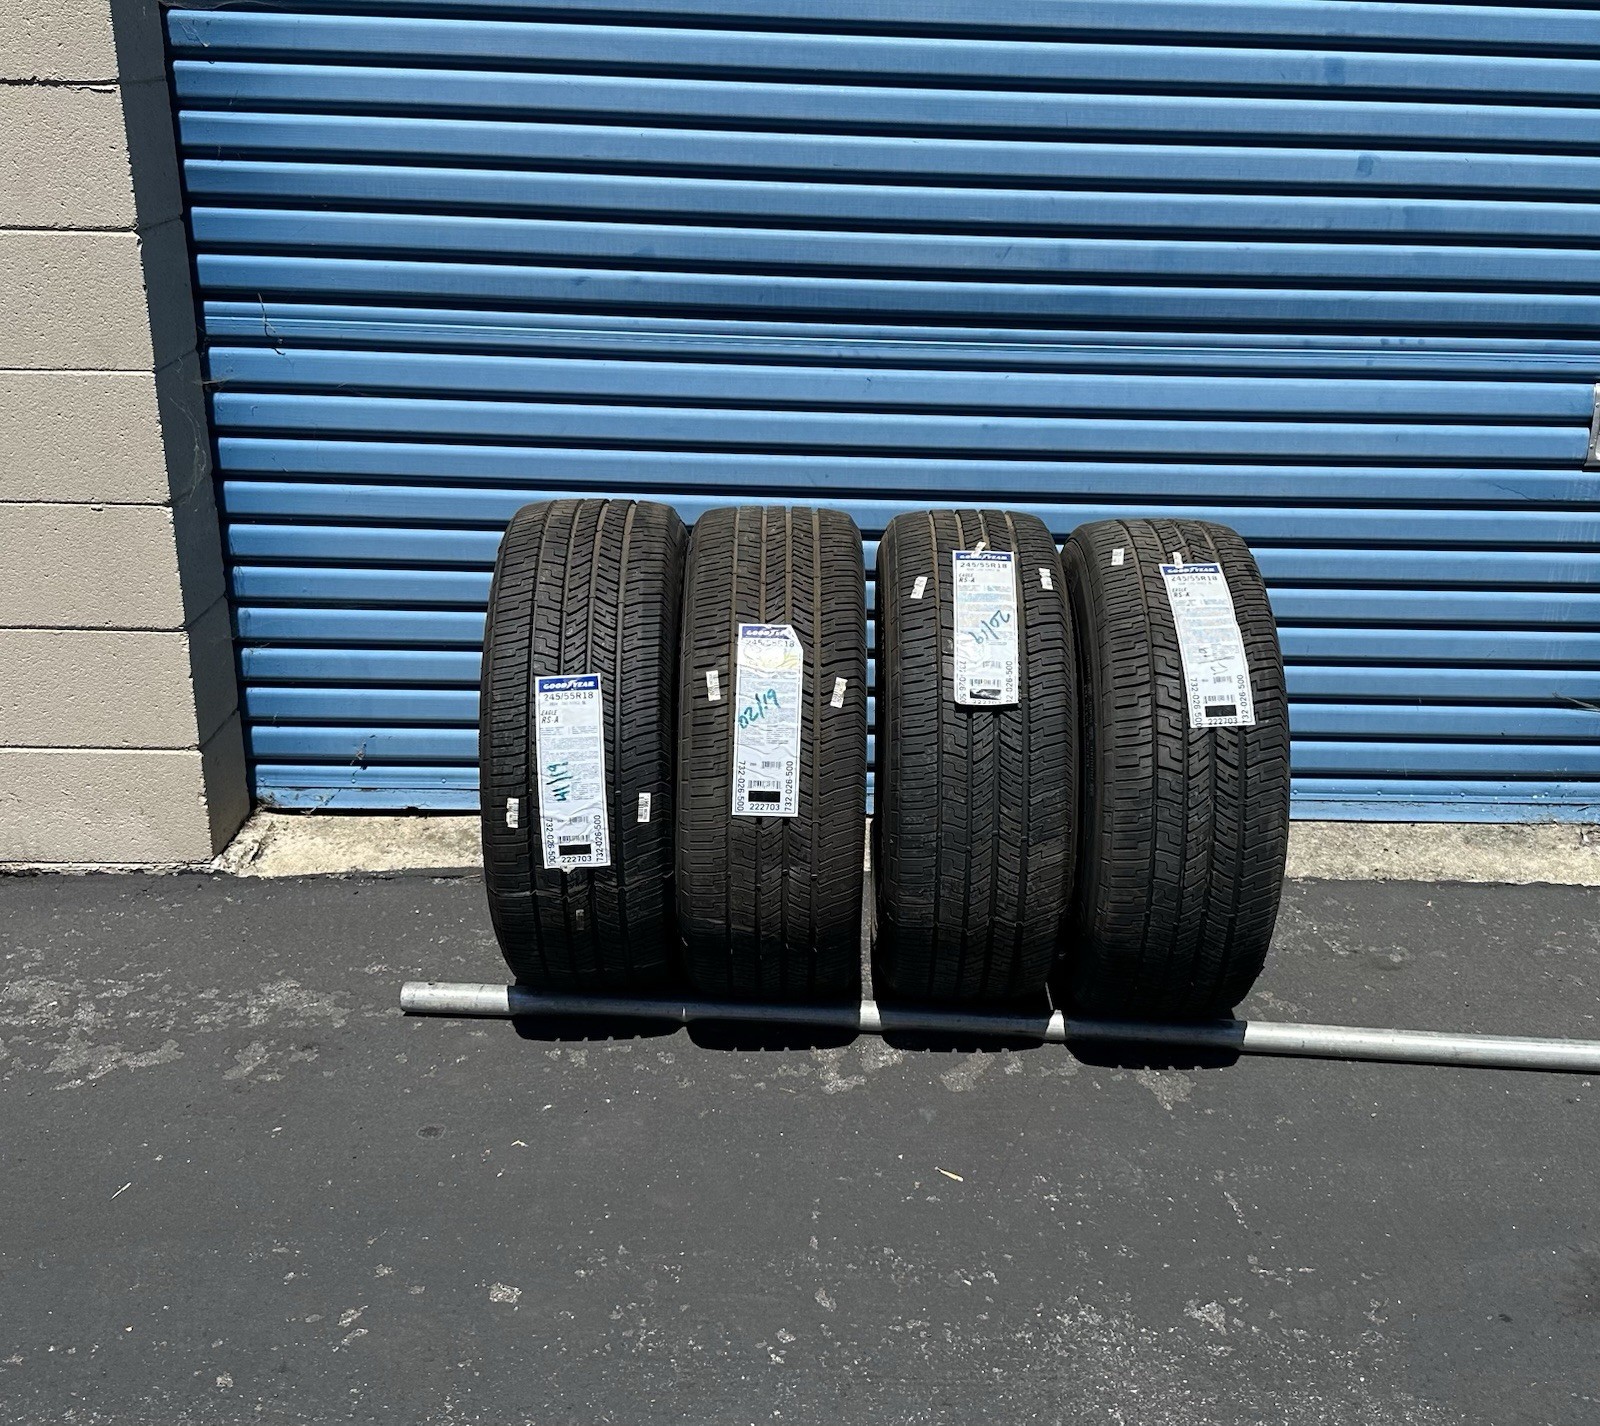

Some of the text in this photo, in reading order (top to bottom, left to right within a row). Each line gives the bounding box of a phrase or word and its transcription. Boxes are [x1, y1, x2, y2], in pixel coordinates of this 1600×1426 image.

[543, 680, 595, 690] GOODYEAR
[1005, 660, 1013, 703] 32-026-500
[543, 691, 594, 701] 245/55R18
[1190, 677, 1203, 727] 732-026-500
[1236, 674, 1250, 724] 732-026-500
[541, 716, 559, 724] RS-A
[1208, 717, 1238, 725] 222703
[736, 760, 746, 811] 732-026-500
[784, 760, 794, 811] 732-026-500
[749, 803, 780, 811] 222703
[593, 814, 604, 862] 732-026-500
[561, 855, 592, 863] 222703
